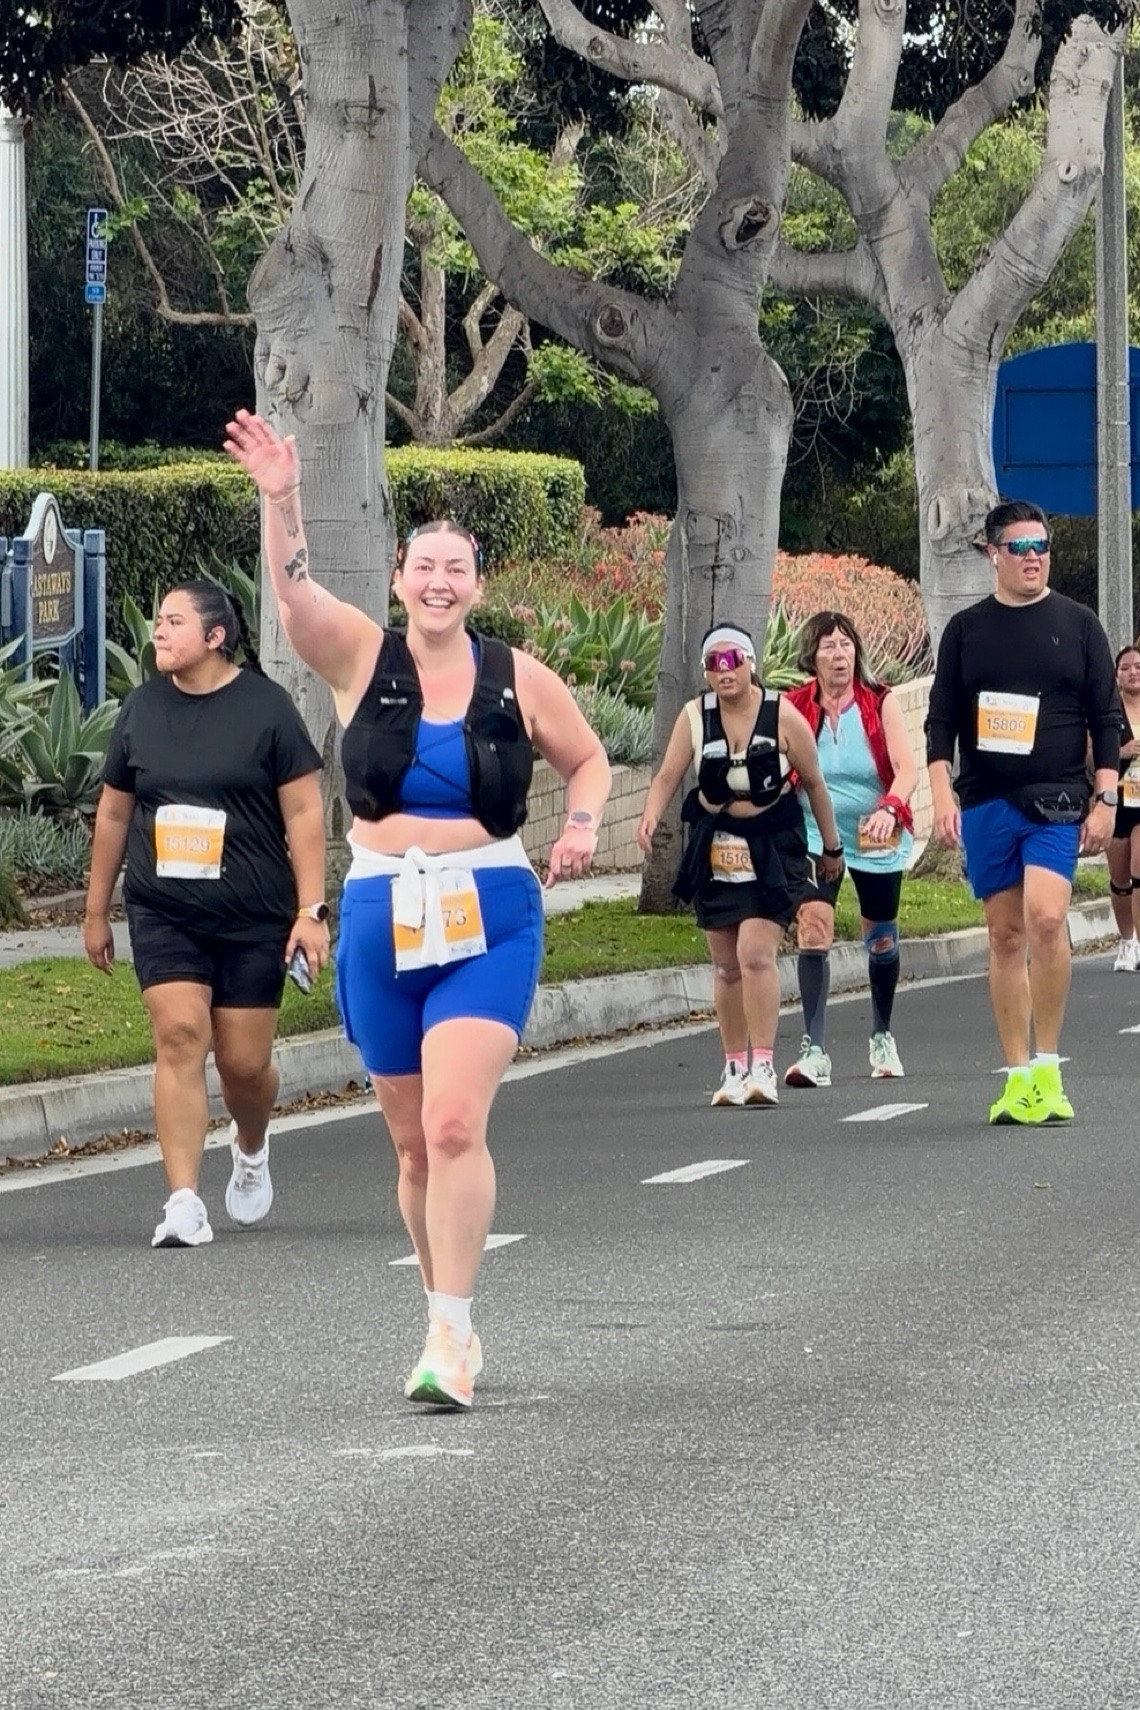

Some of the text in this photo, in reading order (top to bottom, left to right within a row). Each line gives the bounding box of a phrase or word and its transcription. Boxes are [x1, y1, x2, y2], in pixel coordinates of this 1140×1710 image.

[32, 571, 71, 598] ASTAWAYS
[39, 599, 60, 624] PARK
[987, 718, 1027, 732] 15809
